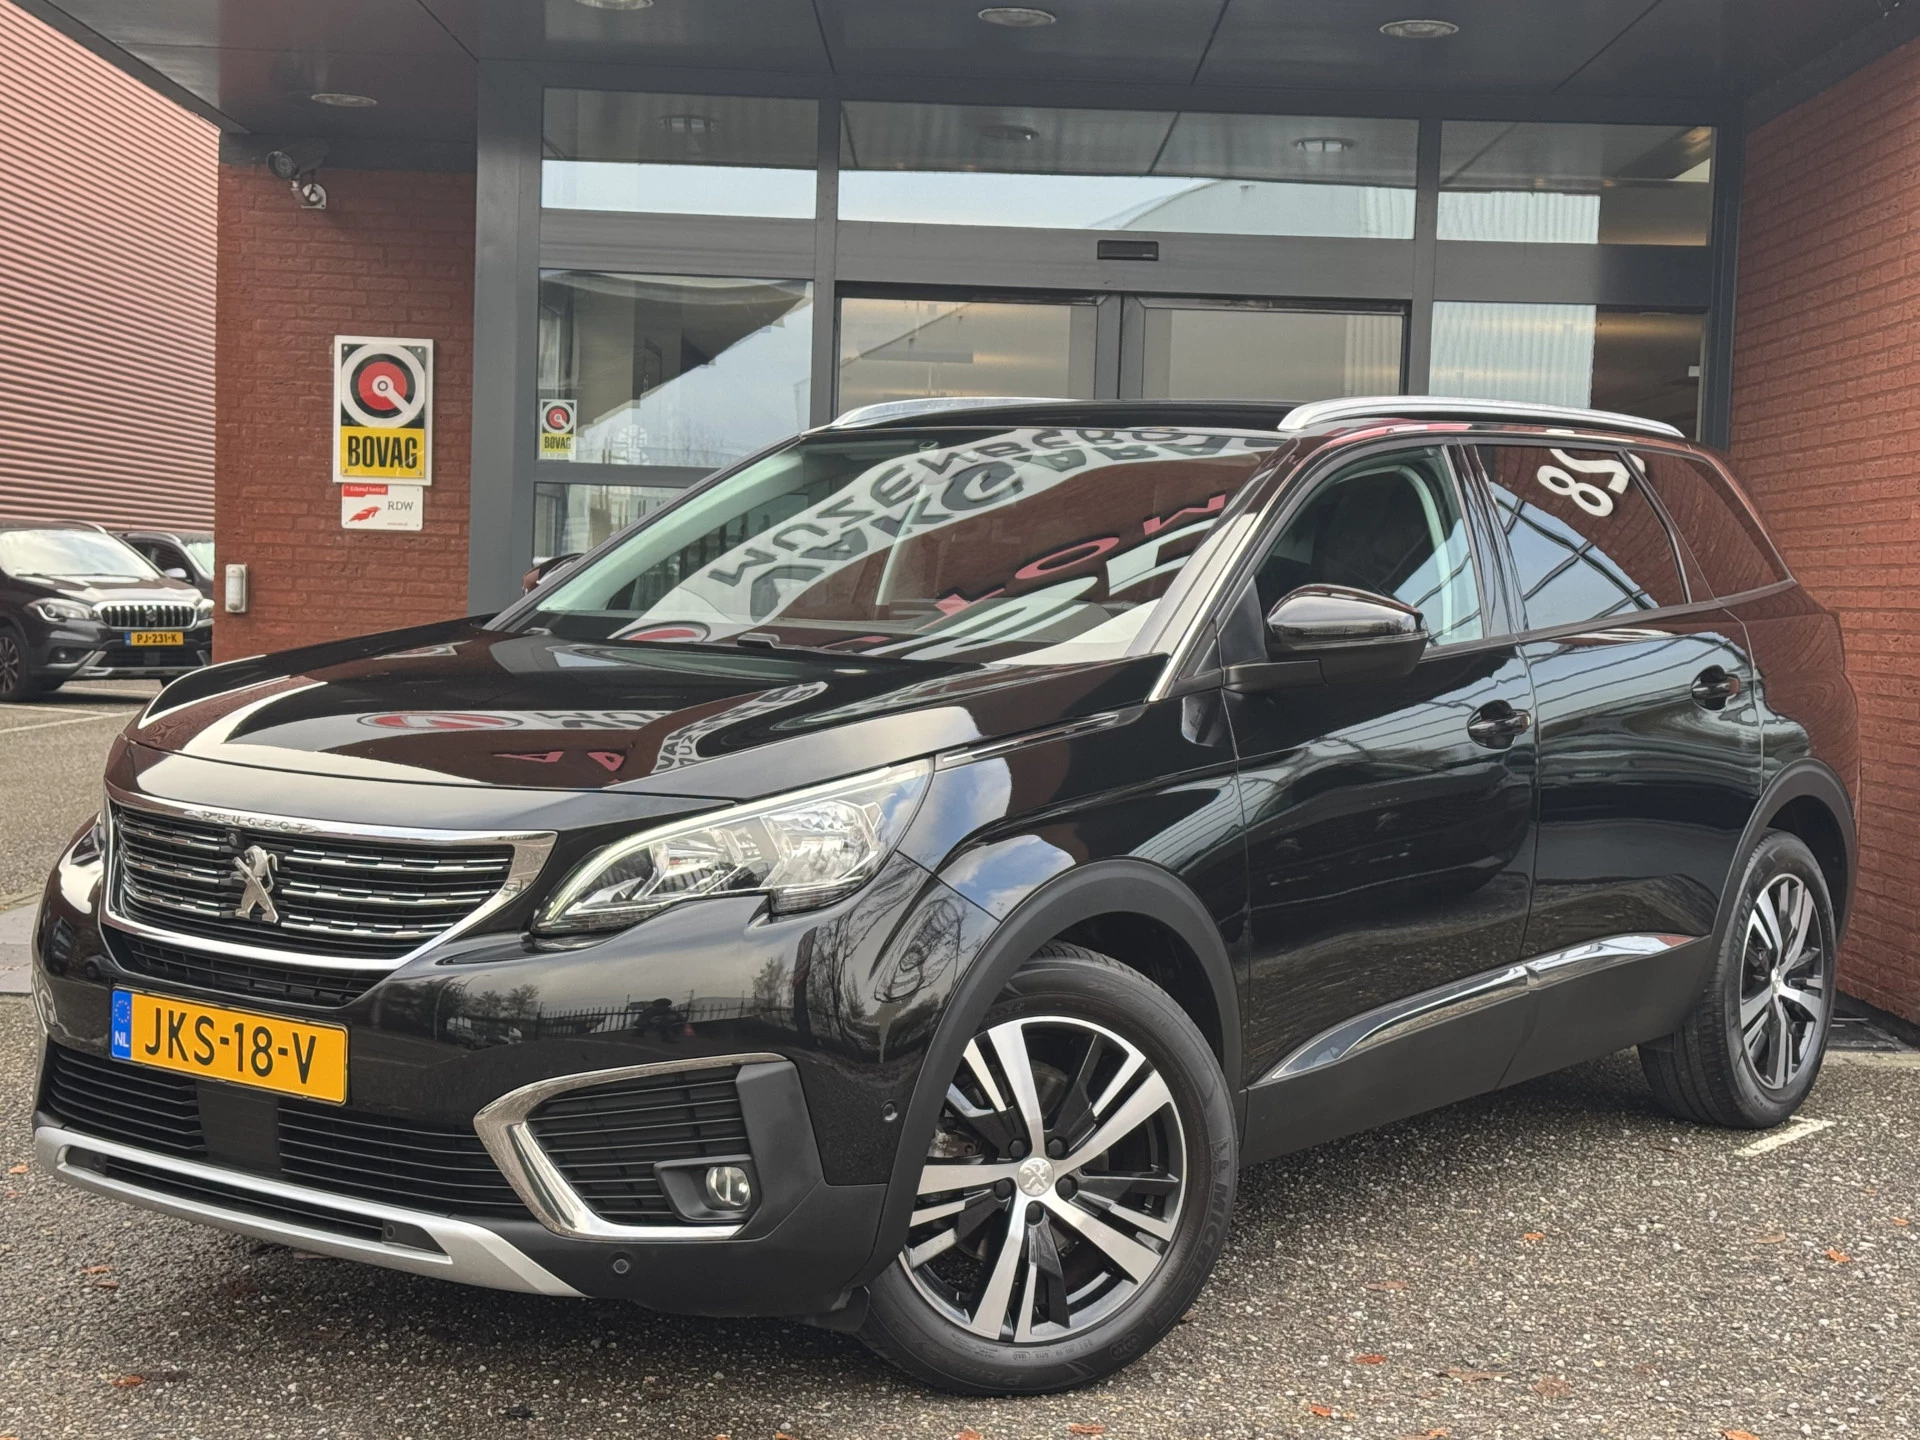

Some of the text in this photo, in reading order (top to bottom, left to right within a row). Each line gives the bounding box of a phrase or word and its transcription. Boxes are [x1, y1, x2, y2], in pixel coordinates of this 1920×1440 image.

[347, 435, 418, 469] BOVAG
[544, 436, 572, 450] BOVAG
[387, 500, 414, 511] RDW
[202, 810, 307, 834] PEUGEOT
[114, 1030, 130, 1049] NL
[145, 1007, 317, 1084] JKS-18-V
